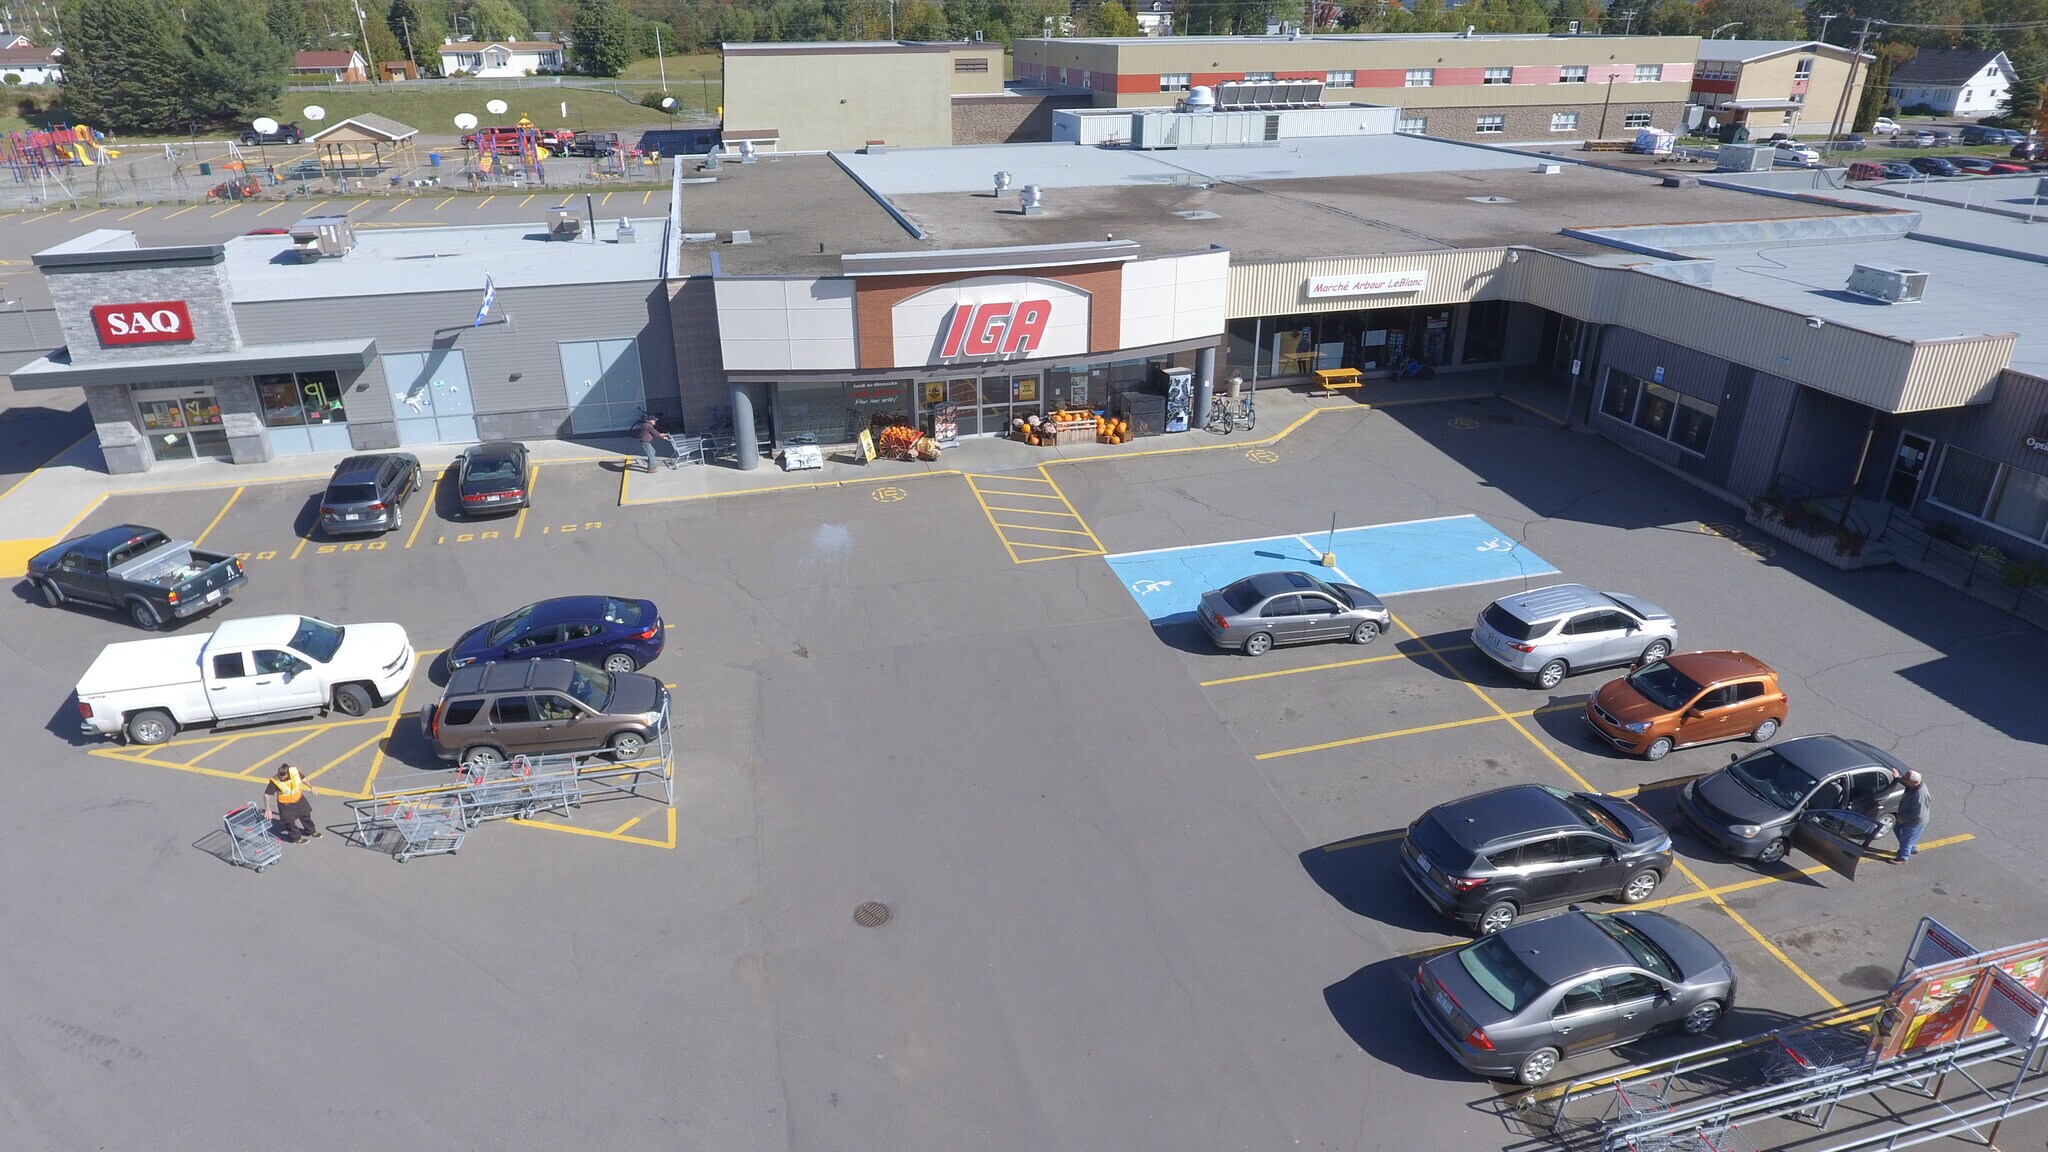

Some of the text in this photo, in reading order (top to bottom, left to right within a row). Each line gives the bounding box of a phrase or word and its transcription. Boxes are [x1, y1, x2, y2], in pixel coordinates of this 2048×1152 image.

[1313, 277, 1424, 293] Marché Arbour LeBlanc
[107, 309, 180, 336] SAQ
[940, 299, 1052, 358] IGA
[2026, 437, 2048, 452] Opti
[316, 541, 388, 554] SAQ
[233, 551, 278, 561] AQ
